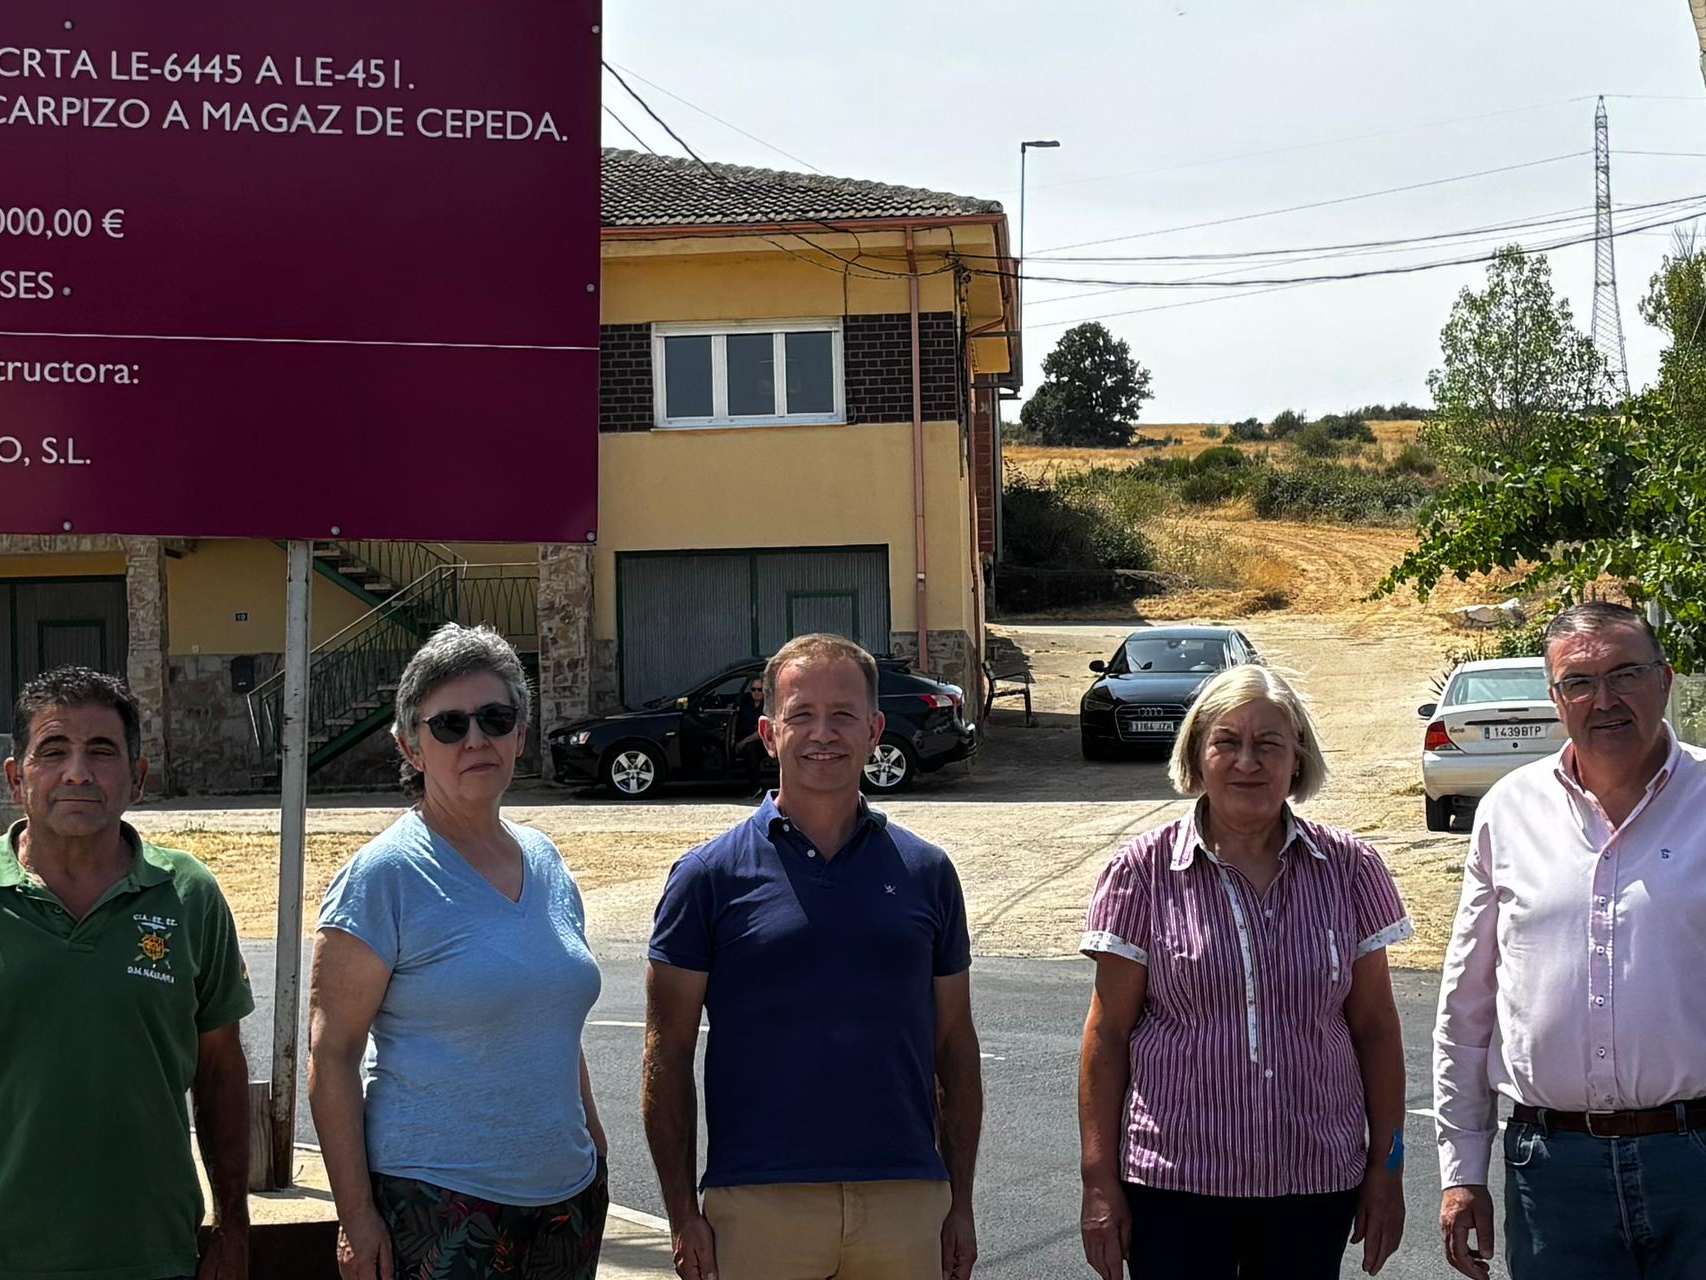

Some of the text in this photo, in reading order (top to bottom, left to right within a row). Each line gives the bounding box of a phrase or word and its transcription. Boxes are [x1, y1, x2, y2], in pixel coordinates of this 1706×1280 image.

[110, 50, 243, 85] LE-6445
[254, 55, 283, 86] A
[162, 99, 190, 130] A
[202, 100, 344, 135] MAGAZ
[355, 105, 405, 137] DE
[416, 107, 569, 142] CEPEDA.
[101, 208, 126, 239] €
[41, 436, 92, 465] S.L.
